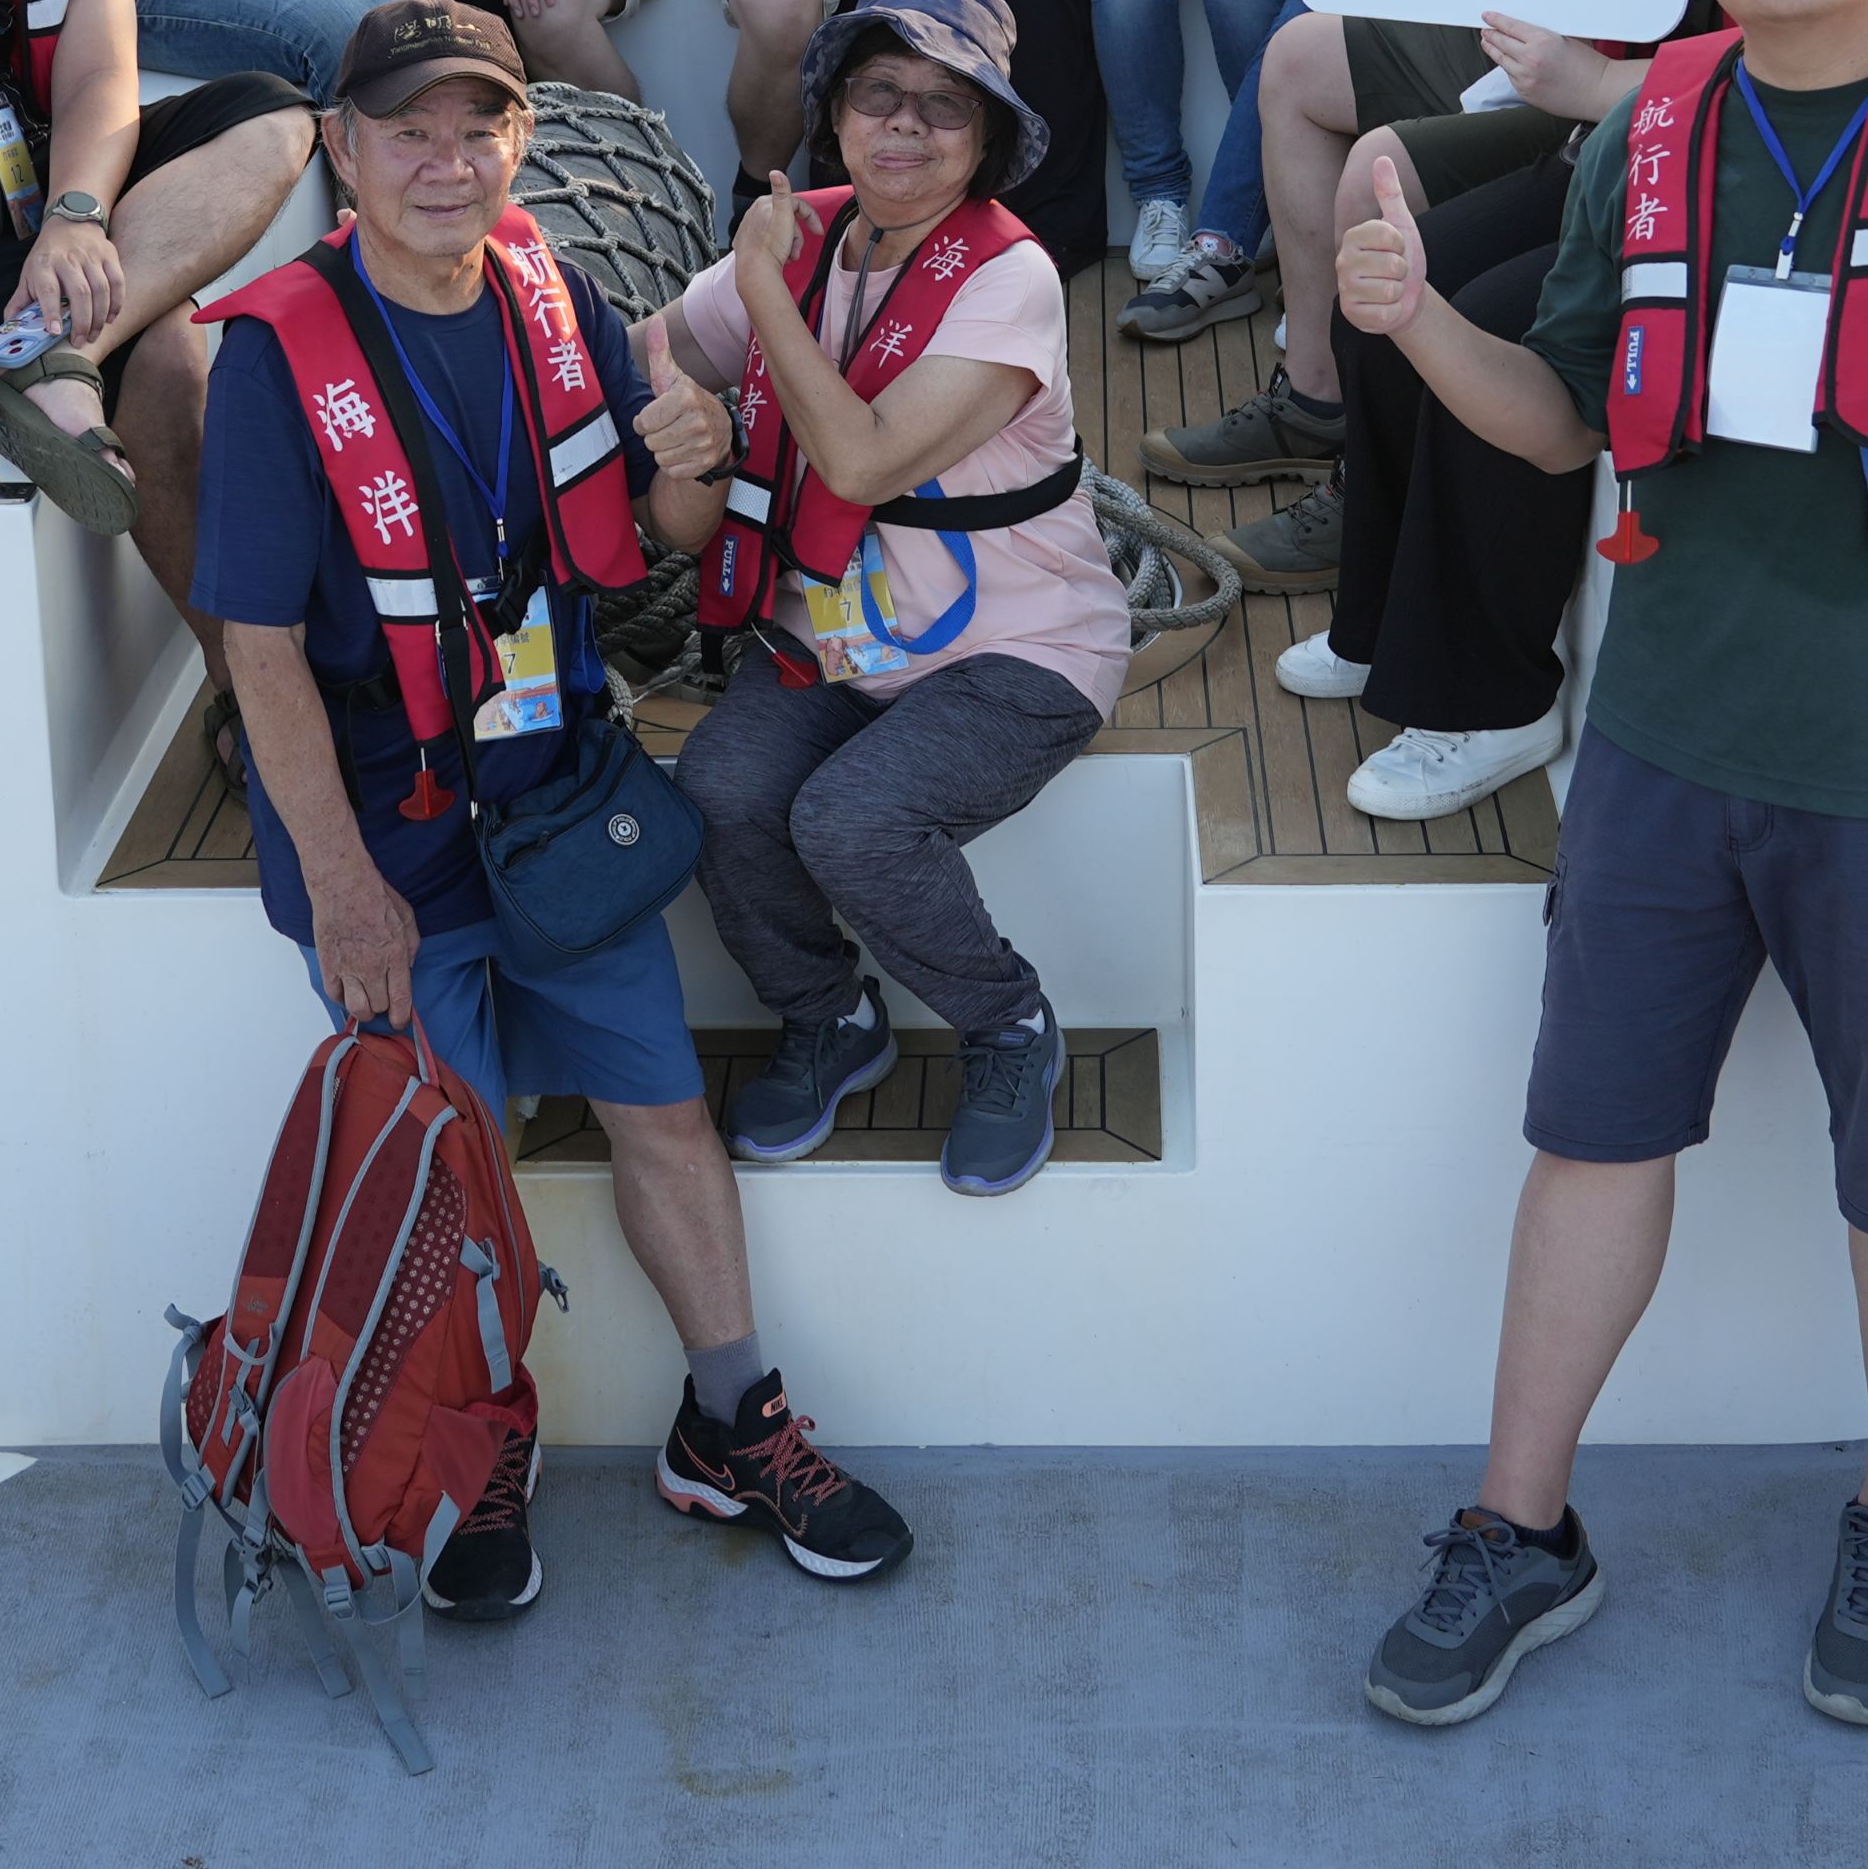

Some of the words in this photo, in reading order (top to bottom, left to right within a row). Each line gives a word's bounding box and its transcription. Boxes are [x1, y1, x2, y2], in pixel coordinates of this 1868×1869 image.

[1626, 95, 1675, 243] 航行者
[507, 238, 586, 391] 航行者
[869, 236, 971, 370] 海洋
[1626, 329, 1641, 374] PULL
[311, 378, 420, 545] 海洋
[721, 539, 734, 575] PULL
[504, 653, 516, 675] 7
[771, 1396, 783, 1415] NIKE
